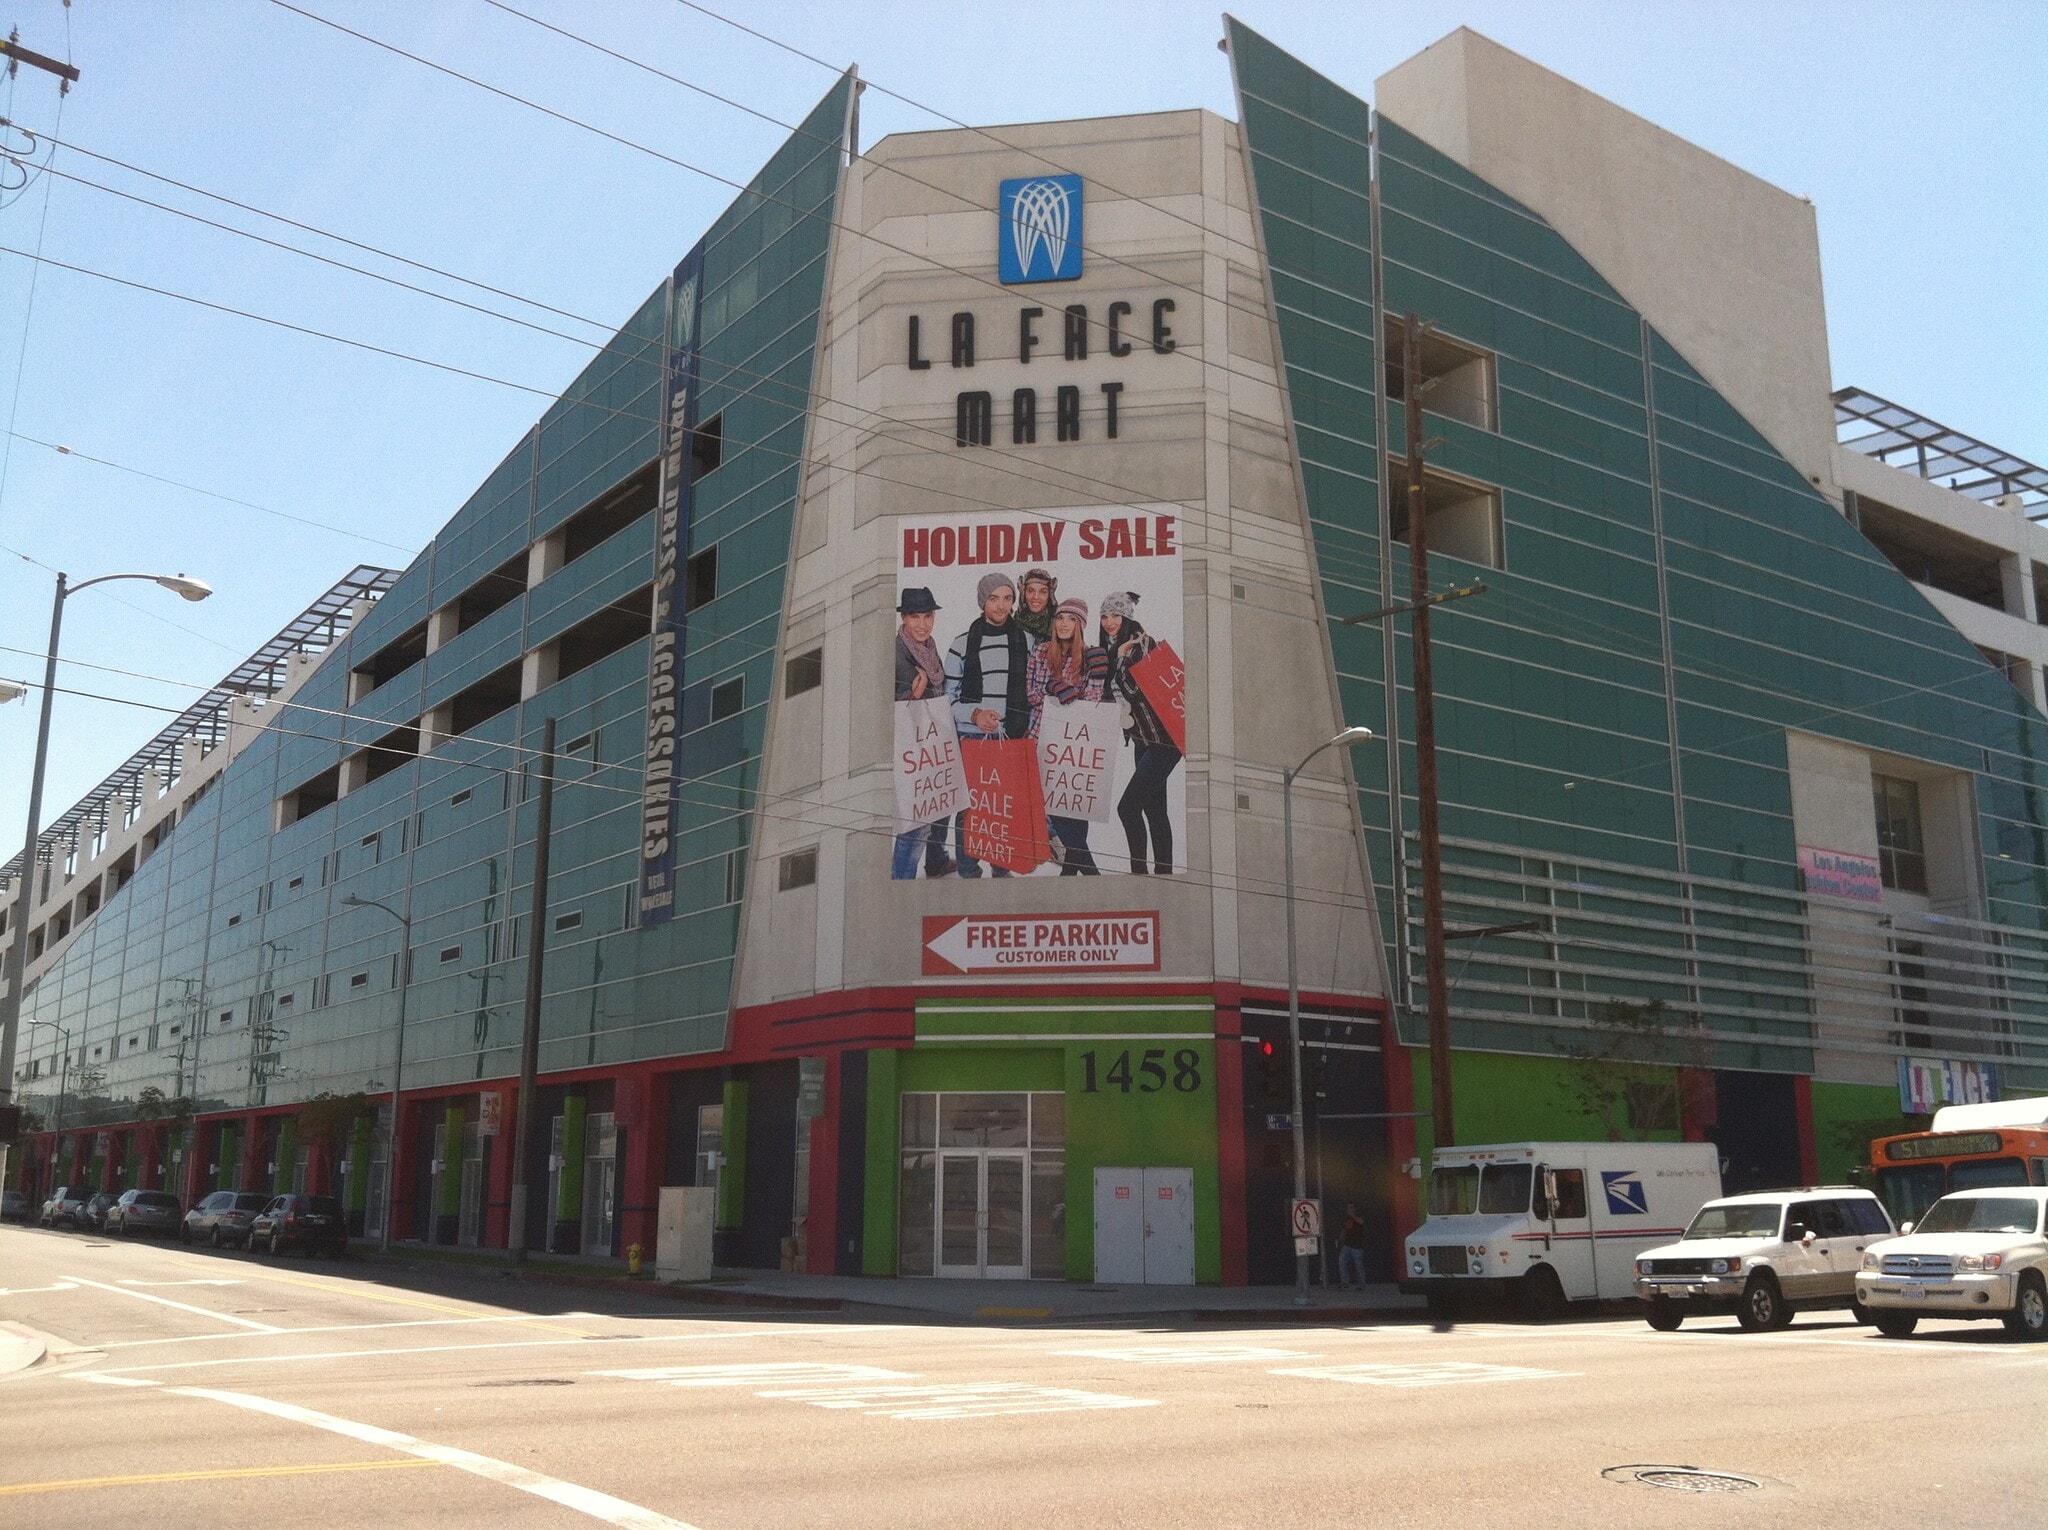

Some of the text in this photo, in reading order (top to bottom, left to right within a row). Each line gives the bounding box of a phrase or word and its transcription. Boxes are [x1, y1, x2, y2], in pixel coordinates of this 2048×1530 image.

[908, 299, 1176, 370] LA FACE
[956, 382, 1124, 448] MART
[658, 485, 679, 592] DRESS
[903, 515, 1176, 568] HOLIDAY SALE
[645, 631, 676, 860] ACCESSORIES
[916, 721, 939, 743] LA
[1064, 722, 1090, 742] LA
[902, 741, 955, 774] SALE
[1044, 743, 1106, 770] SALE
[914, 767, 953, 798] FACE
[980, 766, 1001, 785] LA
[1045, 769, 1096, 792] FACE
[913, 787, 959, 820] MART
[969, 788, 1013, 819] SALE
[970, 815, 1009, 842] FACE
[968, 835, 1015, 864] MART
[966, 922, 1149, 949] FREE PARKING
[995, 949, 1119, 964] CUSTOMER ONLY
[1080, 1048, 1202, 1094] 1458
